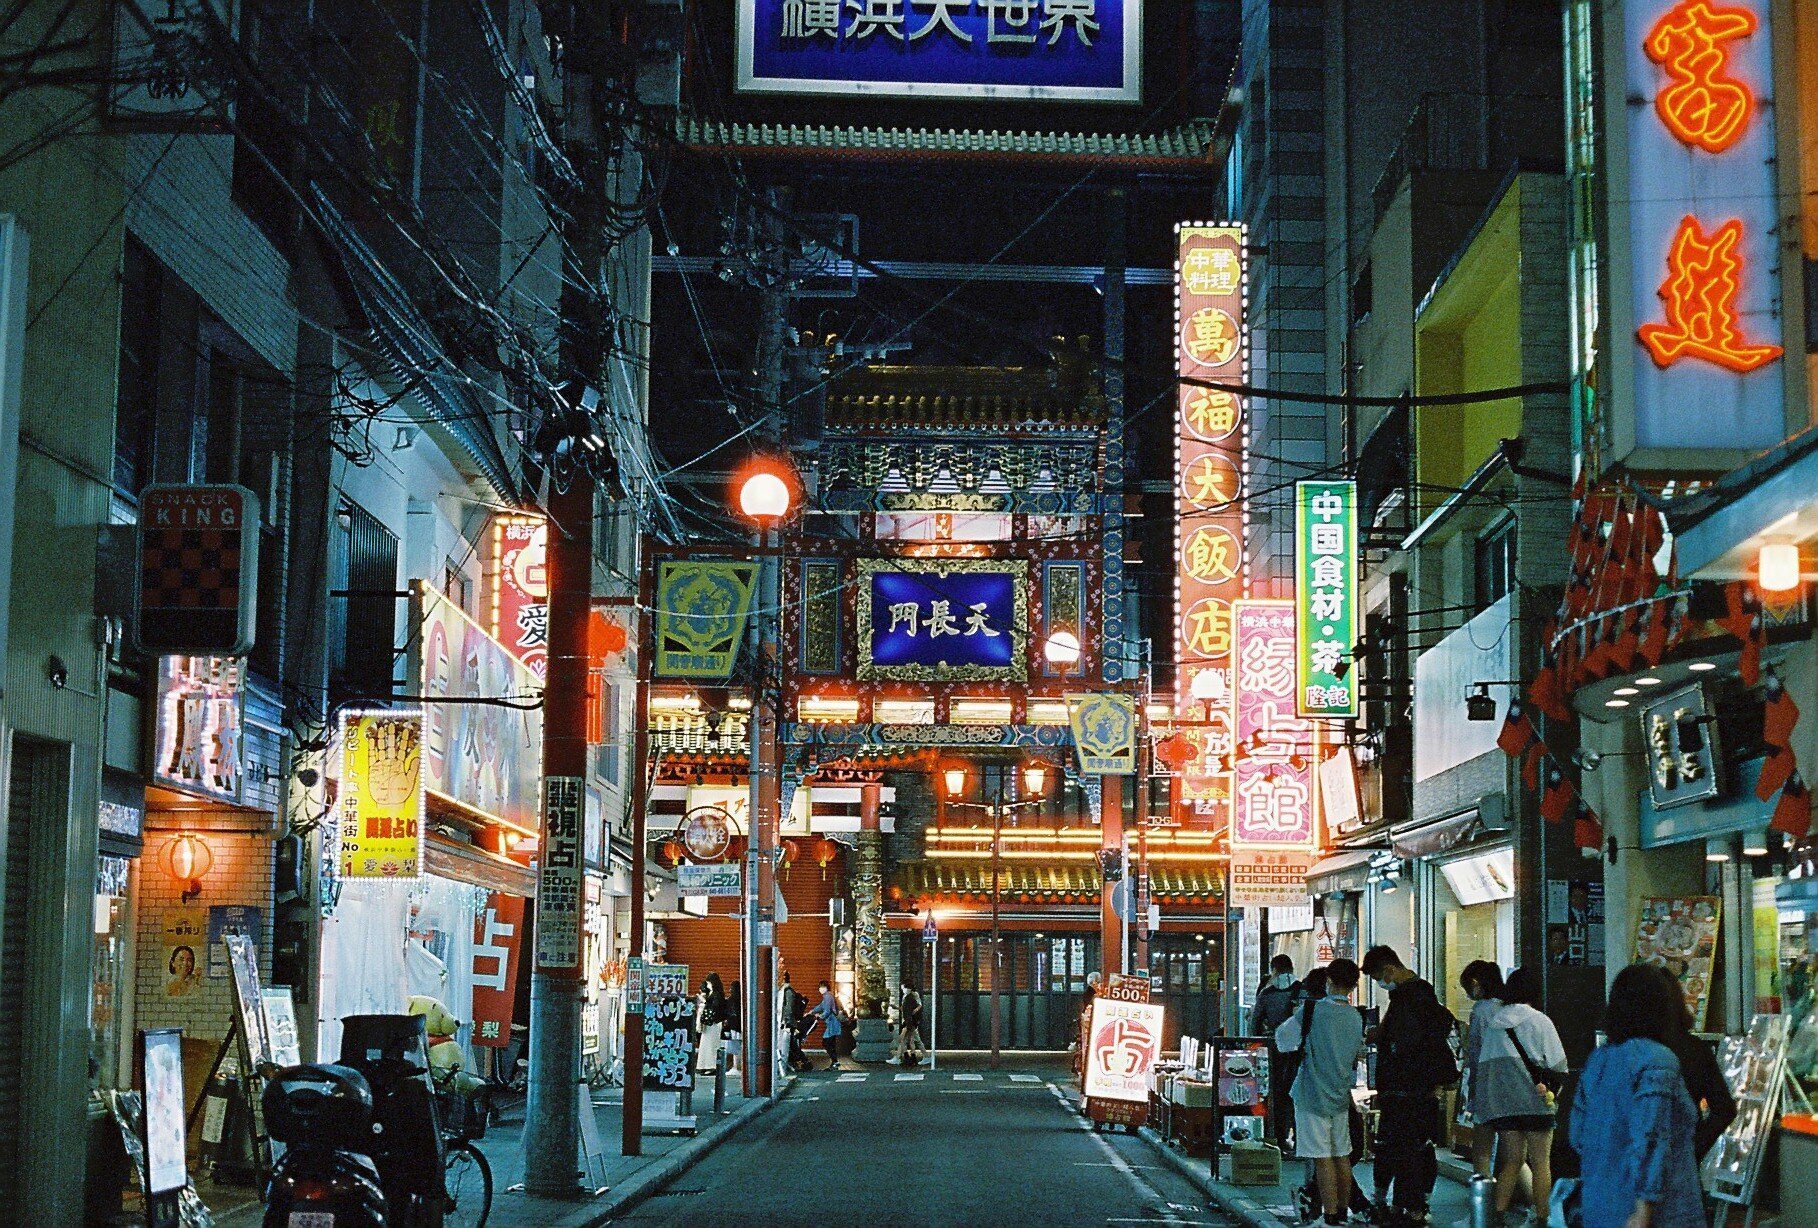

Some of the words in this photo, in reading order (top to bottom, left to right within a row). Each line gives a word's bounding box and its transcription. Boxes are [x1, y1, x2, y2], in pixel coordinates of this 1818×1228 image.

[1189, 251, 1233, 271] 中華
[1188, 271, 1234, 290] 料理
[151, 494, 228, 506] SNACK
[157, 508, 235, 525] KING
[1306, 685, 1350, 708] 隆記
[472, 908, 514, 991] 占
[648, 980, 683, 994] ¥550
